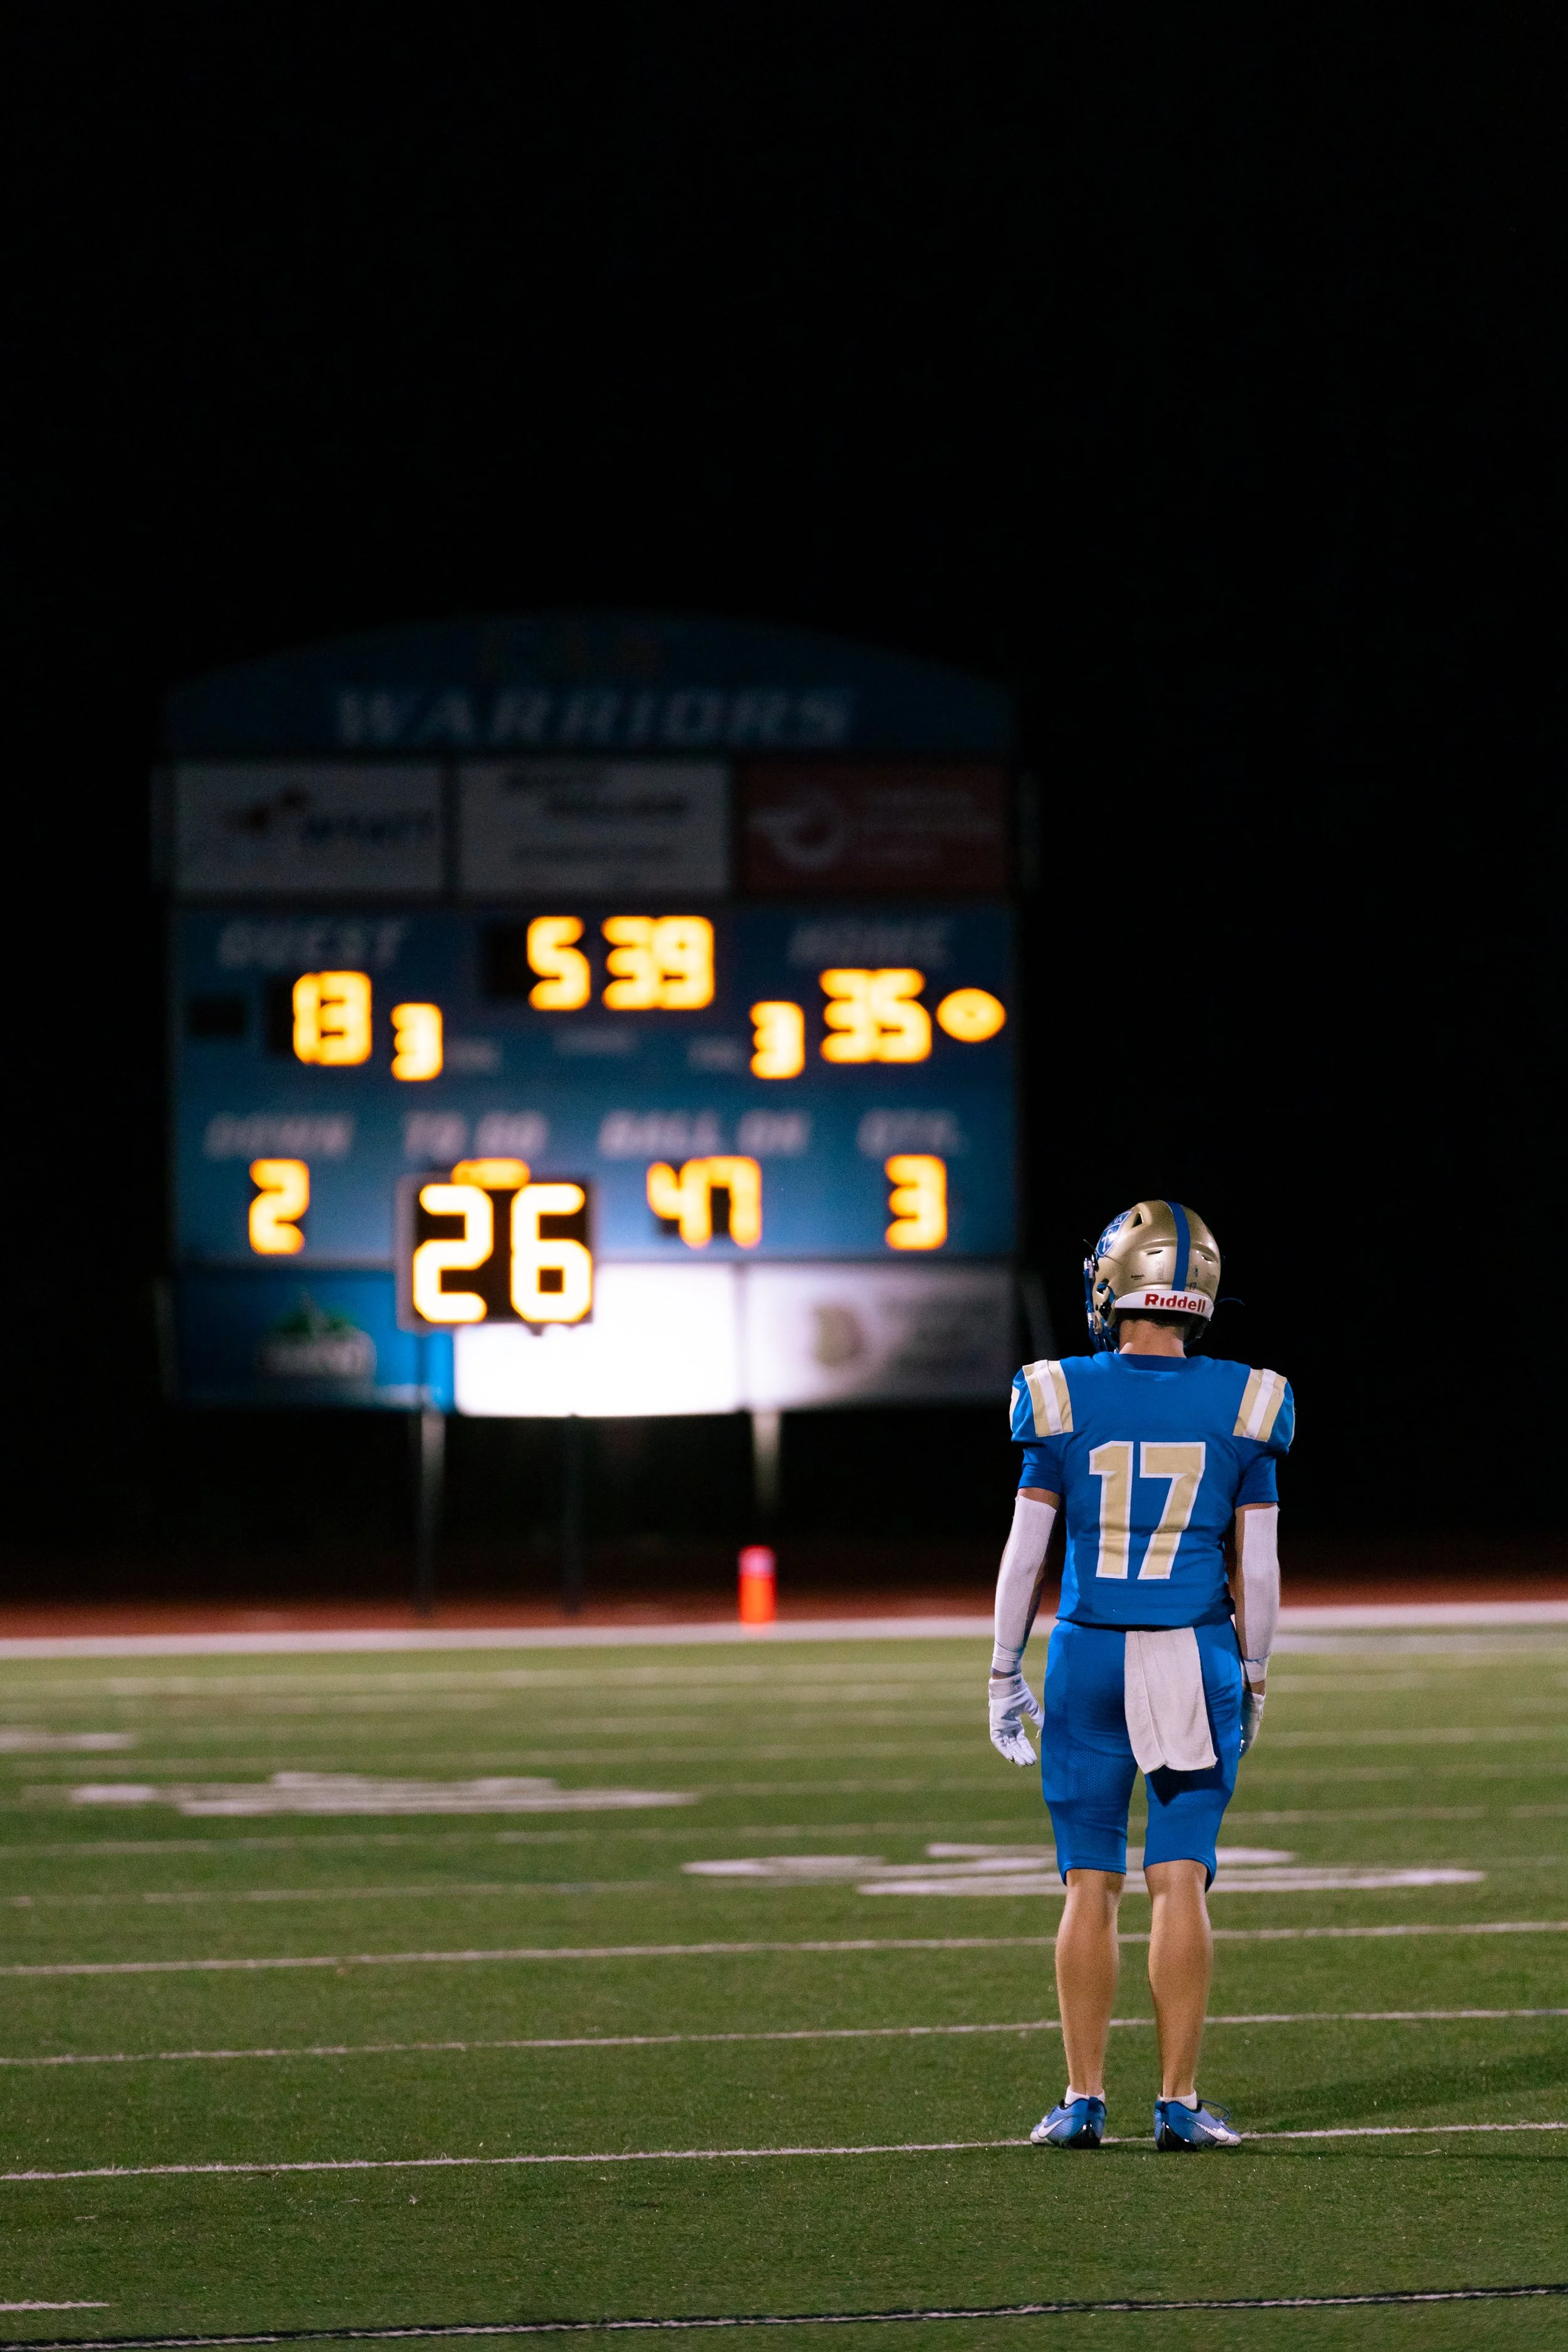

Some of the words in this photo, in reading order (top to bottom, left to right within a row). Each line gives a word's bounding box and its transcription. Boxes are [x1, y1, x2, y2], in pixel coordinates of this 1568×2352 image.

[339, 691, 854, 747] WARRIORS
[218, 918, 406, 968] GUEST
[527, 917, 590, 1010] 5
[604, 916, 714, 1010] 39
[392, 1004, 443, 1081] 3
[751, 1002, 804, 1079] 3
[821, 969, 931, 1062] 35
[403, 1111, 467, 1158] TO
[599, 1109, 723, 1158] BALL
[737, 1109, 812, 1158] ON
[249, 1159, 309, 1254] 2
[647, 1156, 762, 1250] 47
[886, 1155, 946, 1250] 3
[413, 1183, 592, 1324] 26
[1145, 1293, 1205, 1313] Riddell
[1089, 1441, 1205, 1580] 17
